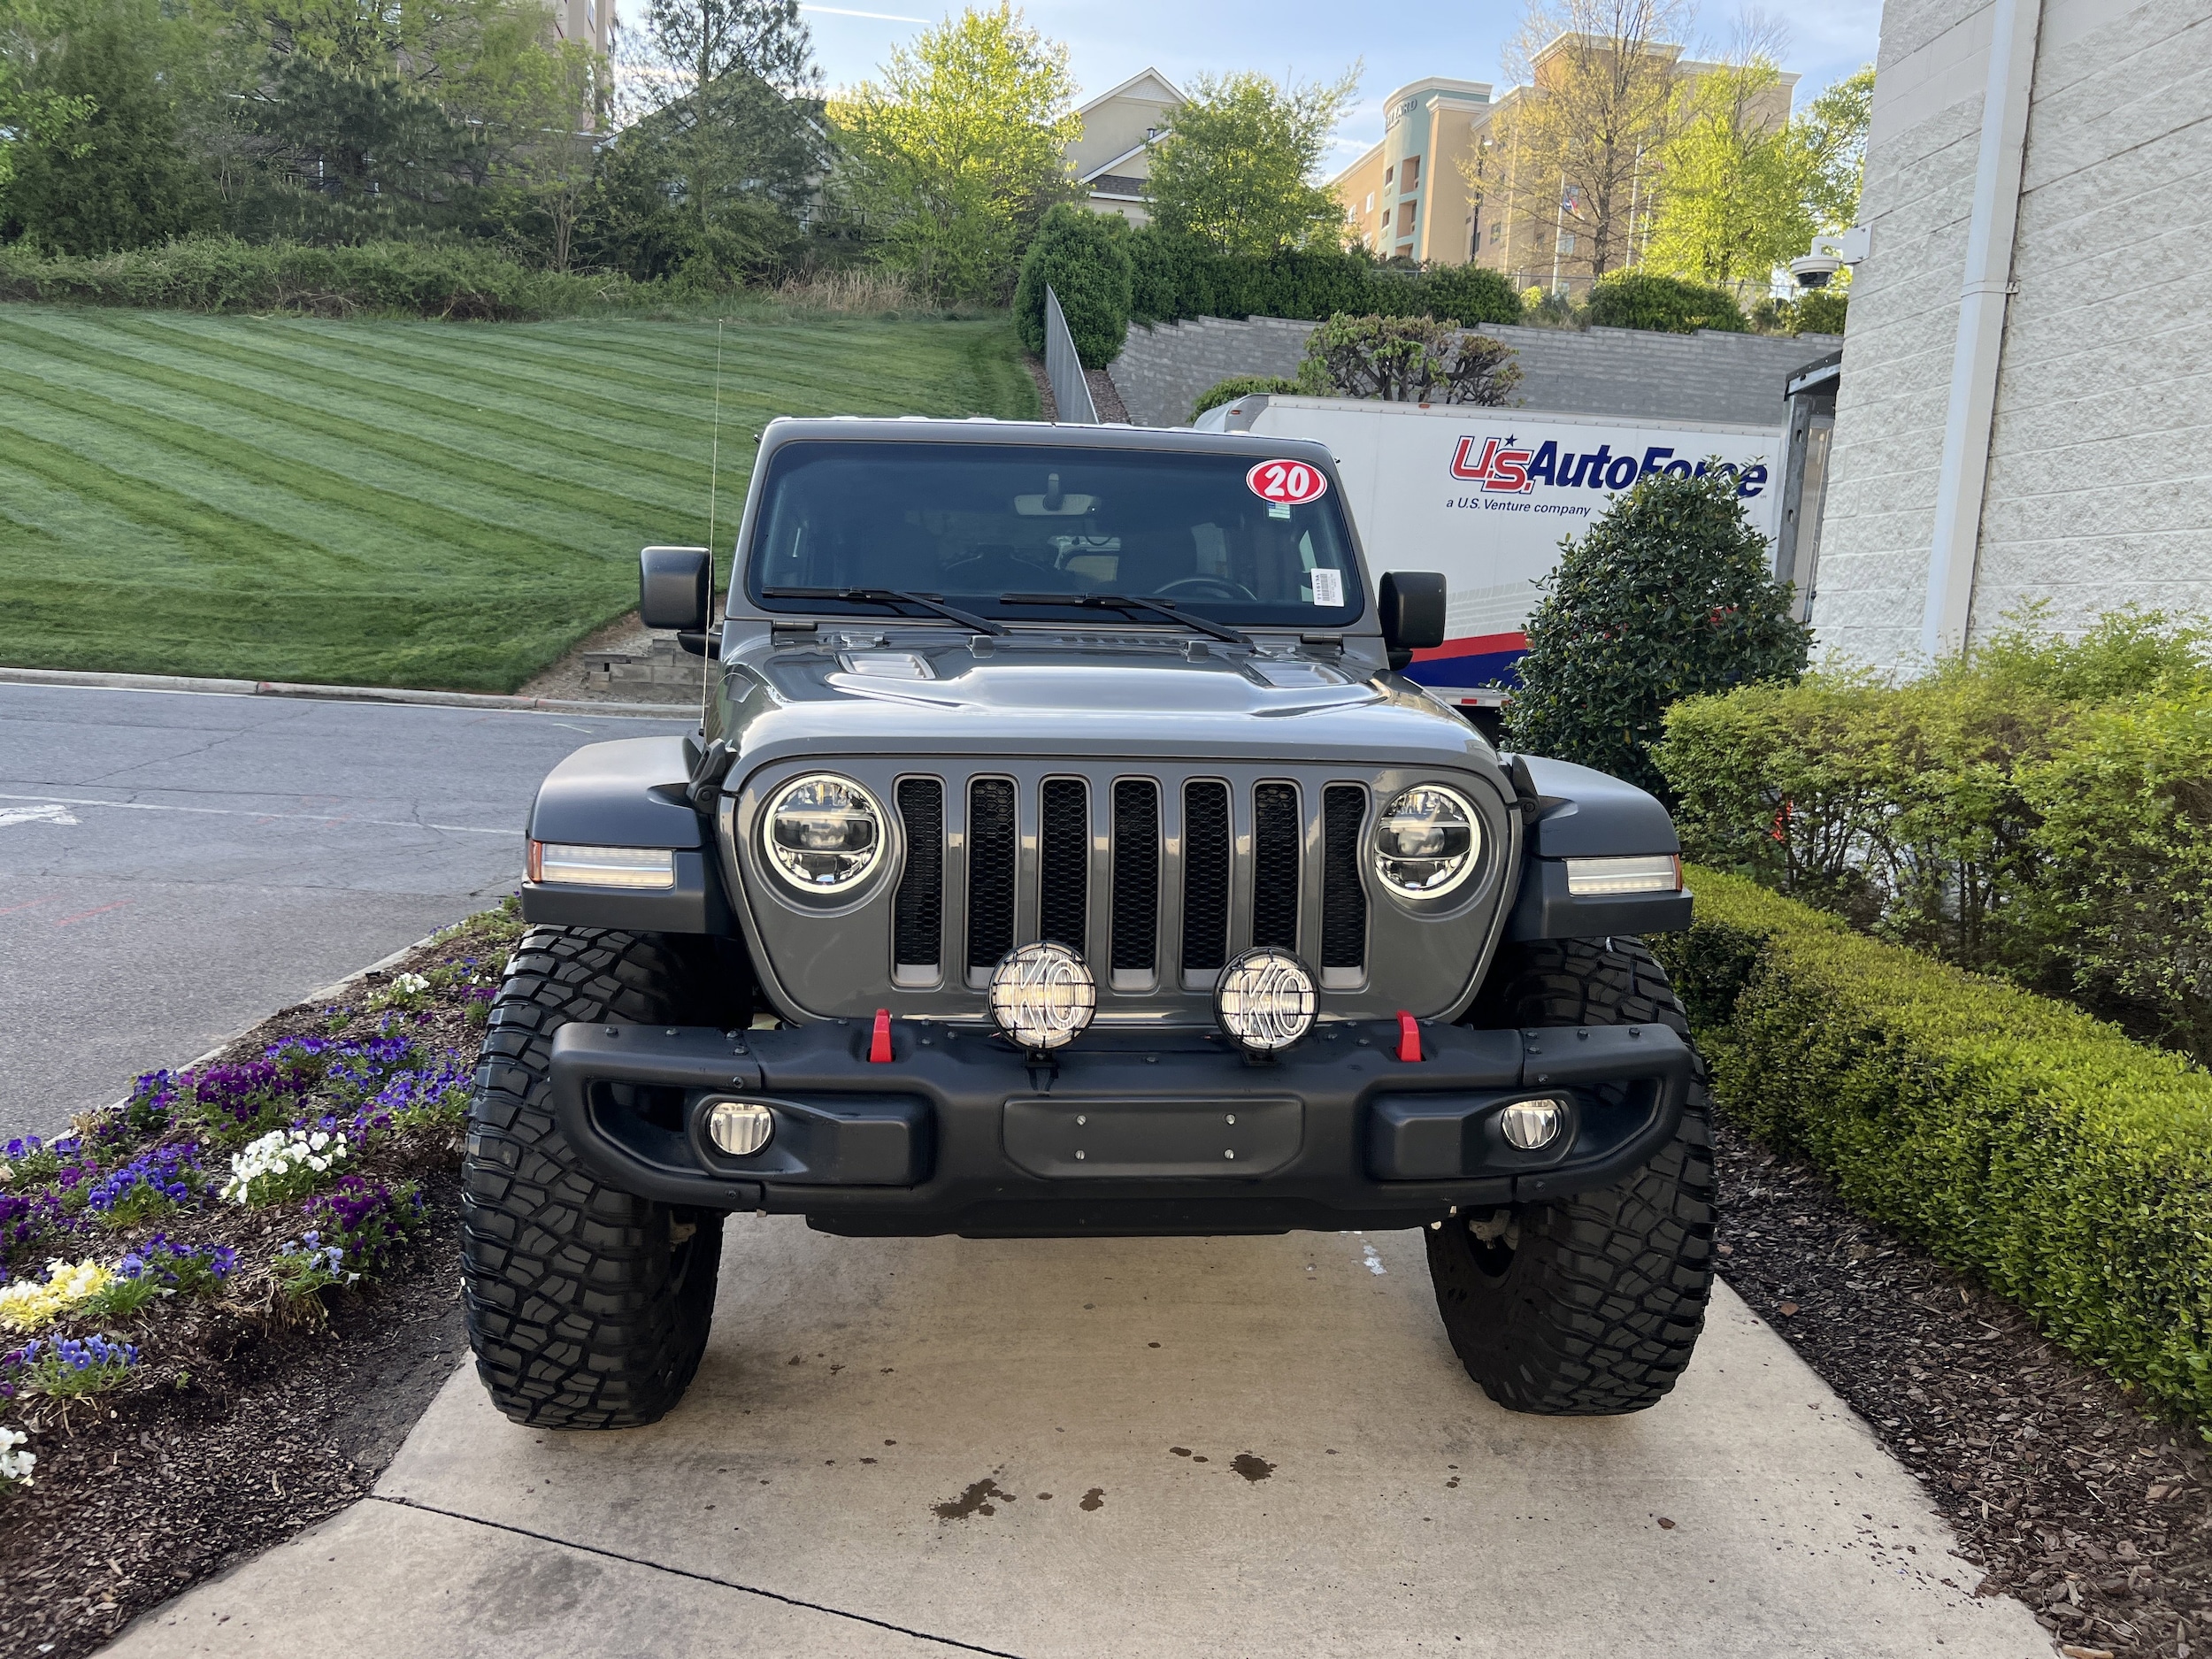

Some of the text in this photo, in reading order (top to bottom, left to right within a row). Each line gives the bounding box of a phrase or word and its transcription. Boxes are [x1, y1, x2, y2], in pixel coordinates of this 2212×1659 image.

[1264, 465, 1310, 498] 20
[1446, 497, 1592, 518] a U.S. Venture company
[1010, 953, 1083, 1036] KC
[1239, 962, 1310, 1044] KC
